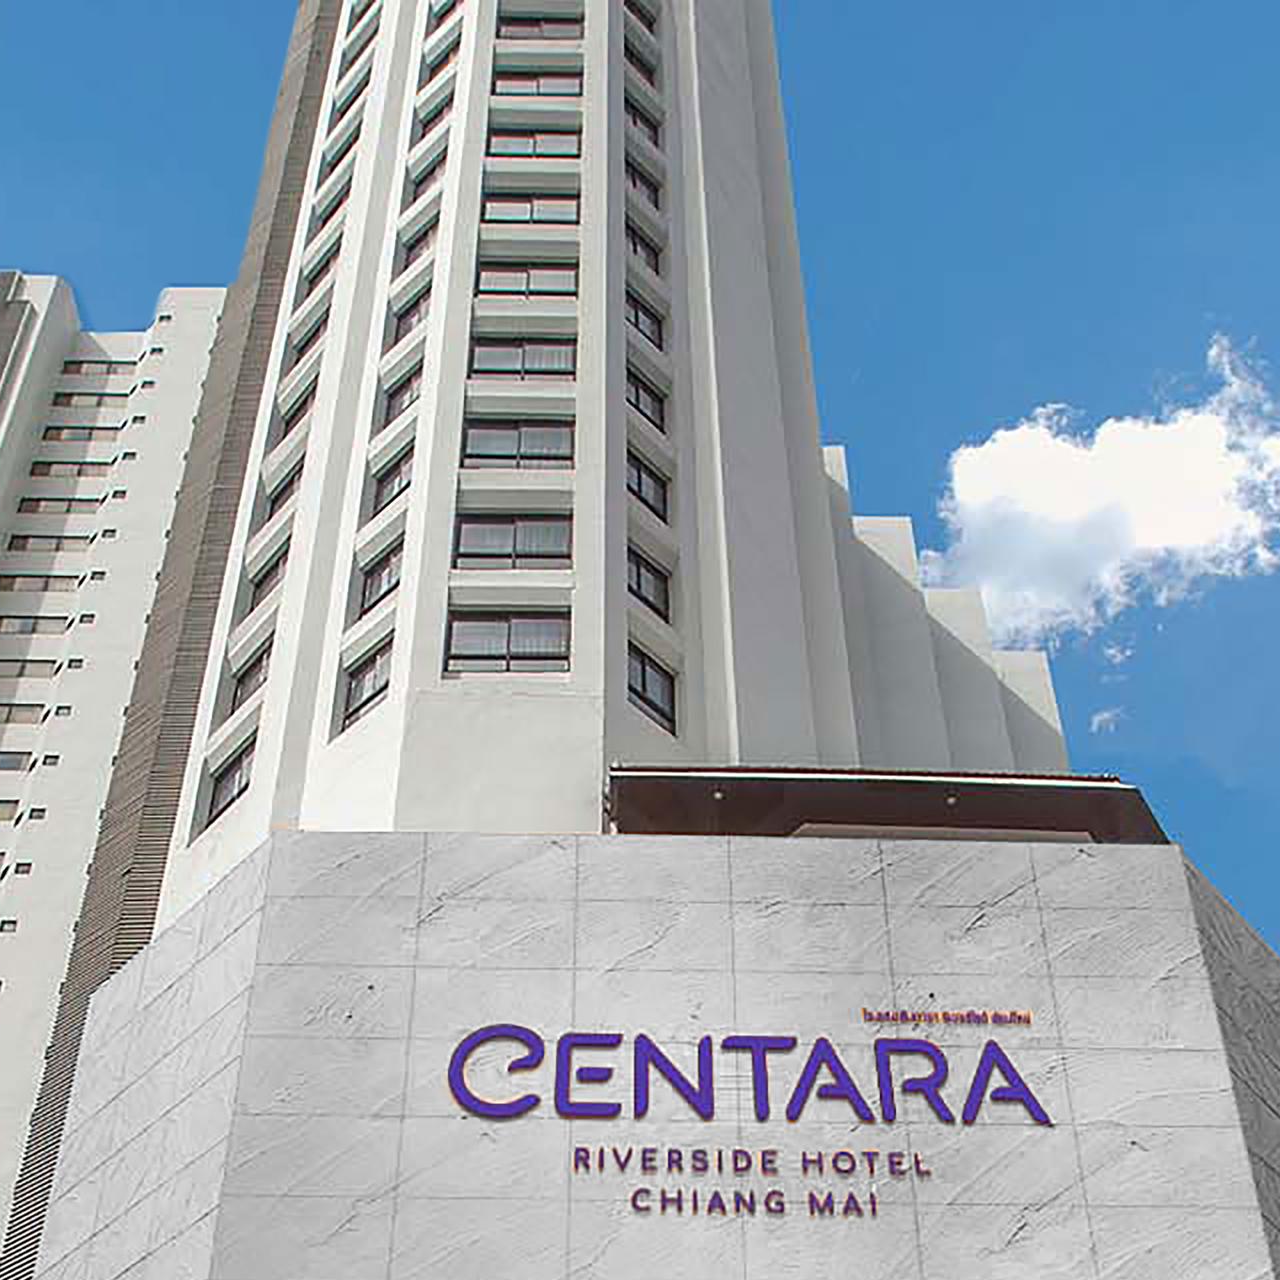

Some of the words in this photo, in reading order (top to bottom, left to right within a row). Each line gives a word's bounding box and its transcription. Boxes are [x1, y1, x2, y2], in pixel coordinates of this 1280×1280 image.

[447, 1023, 1055, 1127] CENTARA
[573, 1147, 779, 1176] RIVERSIDE
[801, 1151, 933, 1178] HOTEL
[631, 1188, 786, 1215] CHIANG
[808, 1192, 879, 1217] MAI
